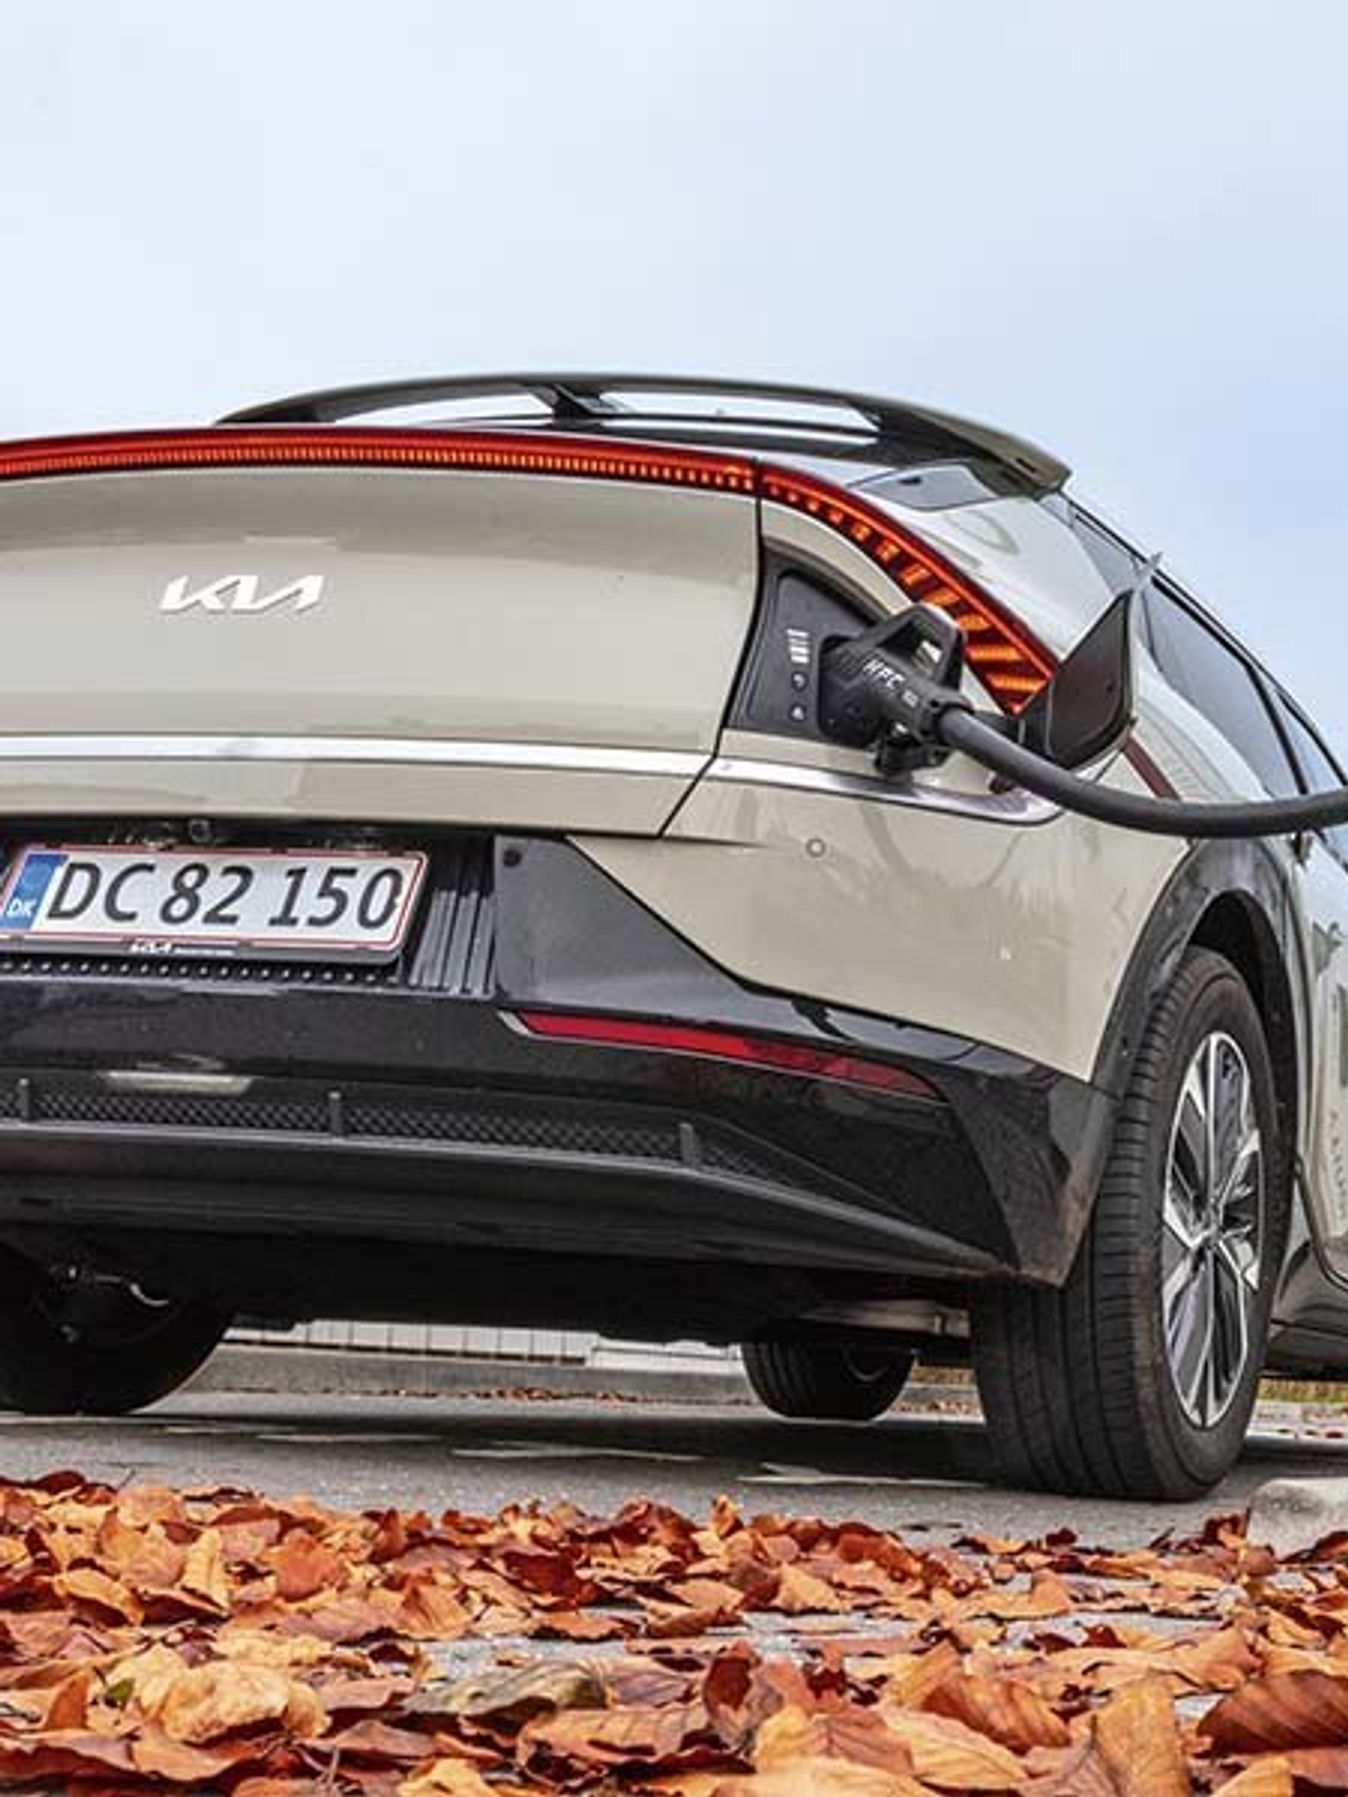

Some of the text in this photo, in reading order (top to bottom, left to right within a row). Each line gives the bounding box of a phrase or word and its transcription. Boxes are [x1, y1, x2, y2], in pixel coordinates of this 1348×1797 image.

[159, 574, 325, 611] KIA
[7, 898, 37, 918] DK
[47, 861, 403, 930] DC 82 150
